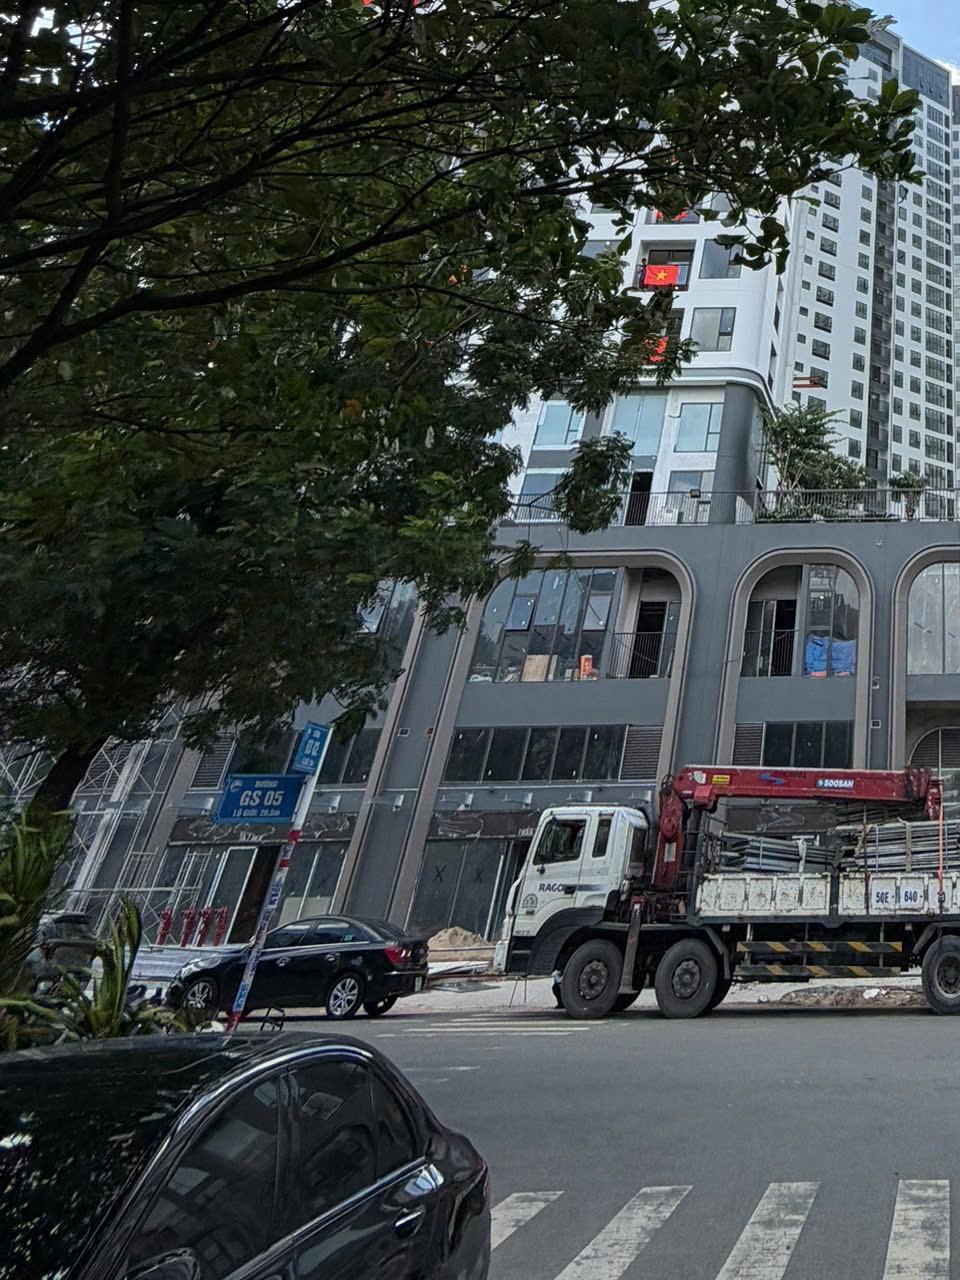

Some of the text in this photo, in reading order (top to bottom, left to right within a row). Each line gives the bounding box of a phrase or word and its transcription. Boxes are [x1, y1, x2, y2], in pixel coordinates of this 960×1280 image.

[824, 779, 854, 789] SOOSAN
[240, 790, 284, 806] GS 05
